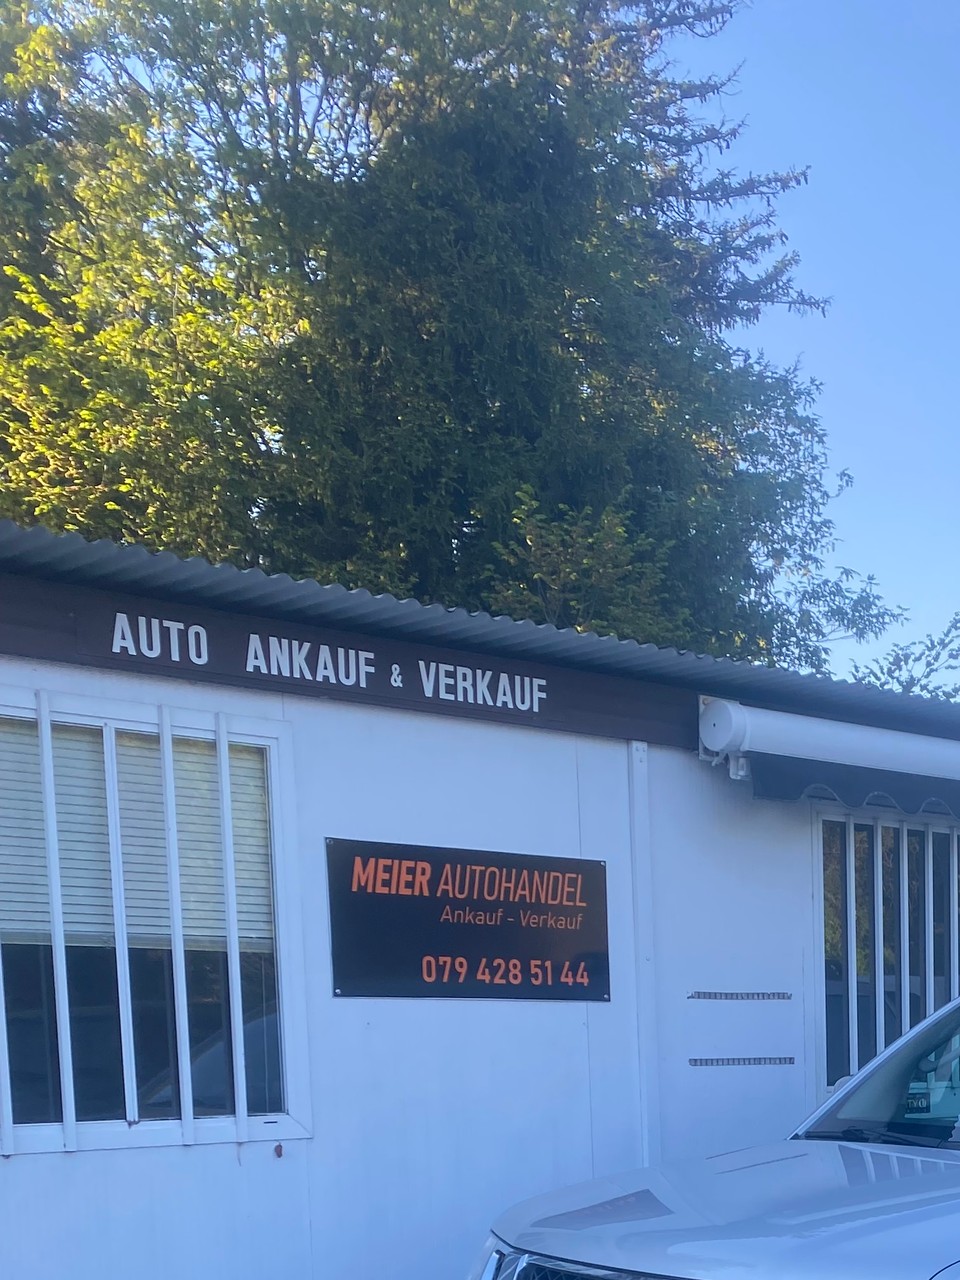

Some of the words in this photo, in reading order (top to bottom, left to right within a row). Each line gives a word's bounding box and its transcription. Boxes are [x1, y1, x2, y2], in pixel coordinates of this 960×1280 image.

[111, 612, 209, 665] AUTO
[246, 633, 375, 688] ANKAUF
[390, 663, 403, 688] &
[418, 660, 547, 713] VERKAUF
[351, 856, 432, 897] MEIER
[436, 863, 587, 907] AUTOHANDEL
[440, 905, 504, 926] Ankauf
[519, 909, 583, 931] Verkauf
[421, 955, 468, 983] 079
[476, 957, 522, 985] 428
[530, 959, 553, 986] 51
[560, 961, 589, 987] 44
